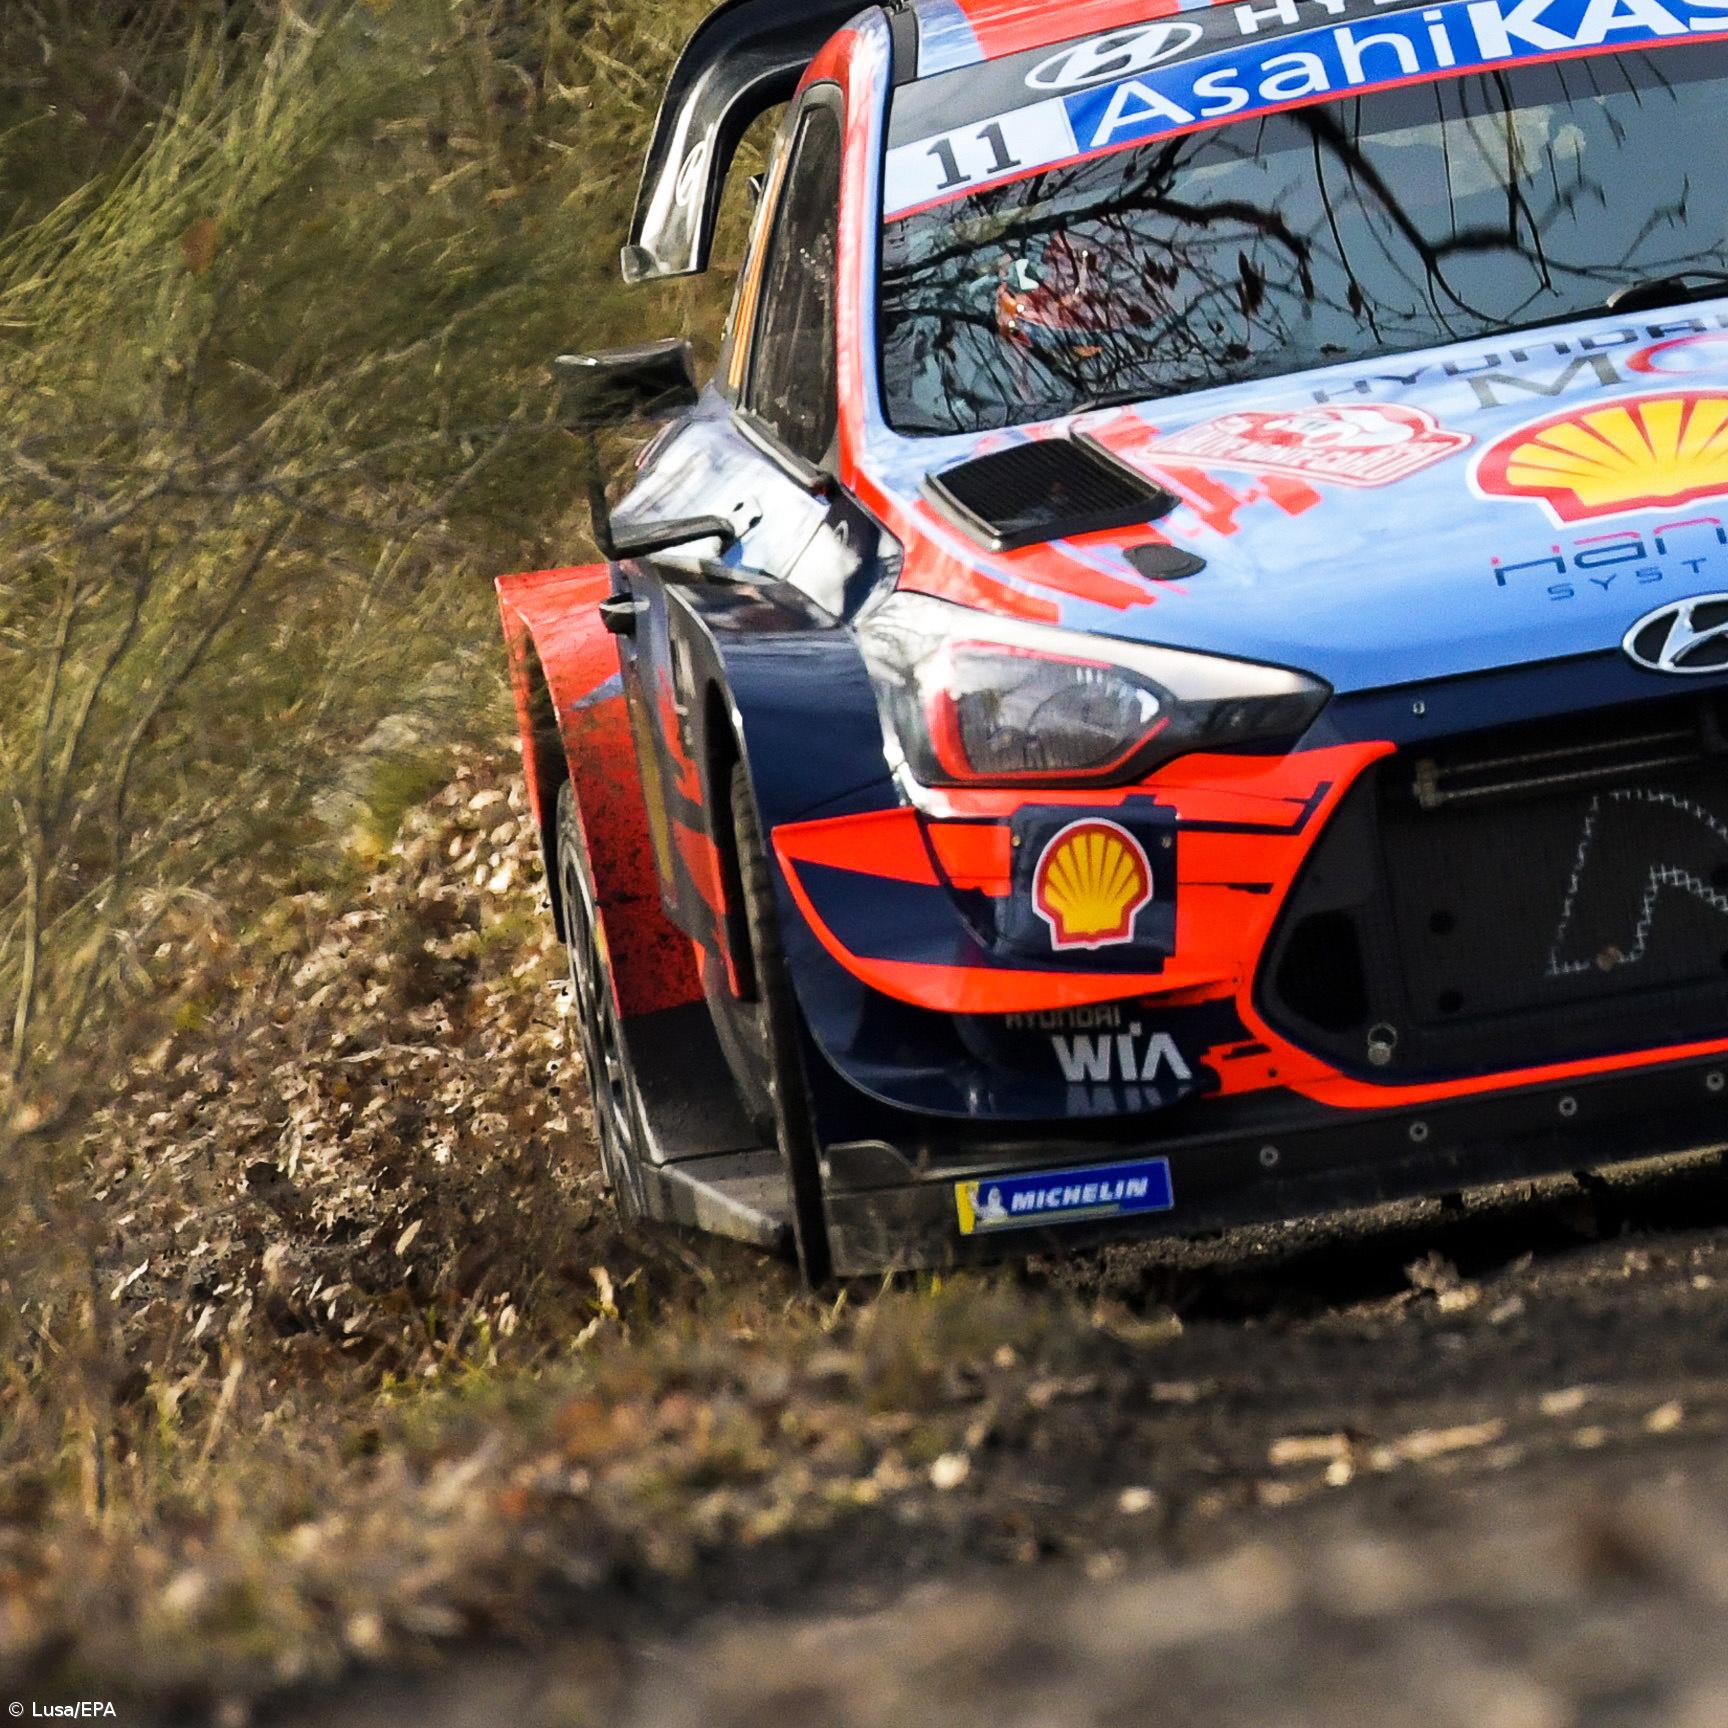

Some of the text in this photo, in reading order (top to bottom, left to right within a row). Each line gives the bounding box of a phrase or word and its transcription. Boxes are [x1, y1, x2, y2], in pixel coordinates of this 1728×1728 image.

[926, 121, 1022, 190] 11
[1004, 1005, 1121, 1029] HYUNDAI
[1011, 1176, 1149, 1212] MICHELIN
